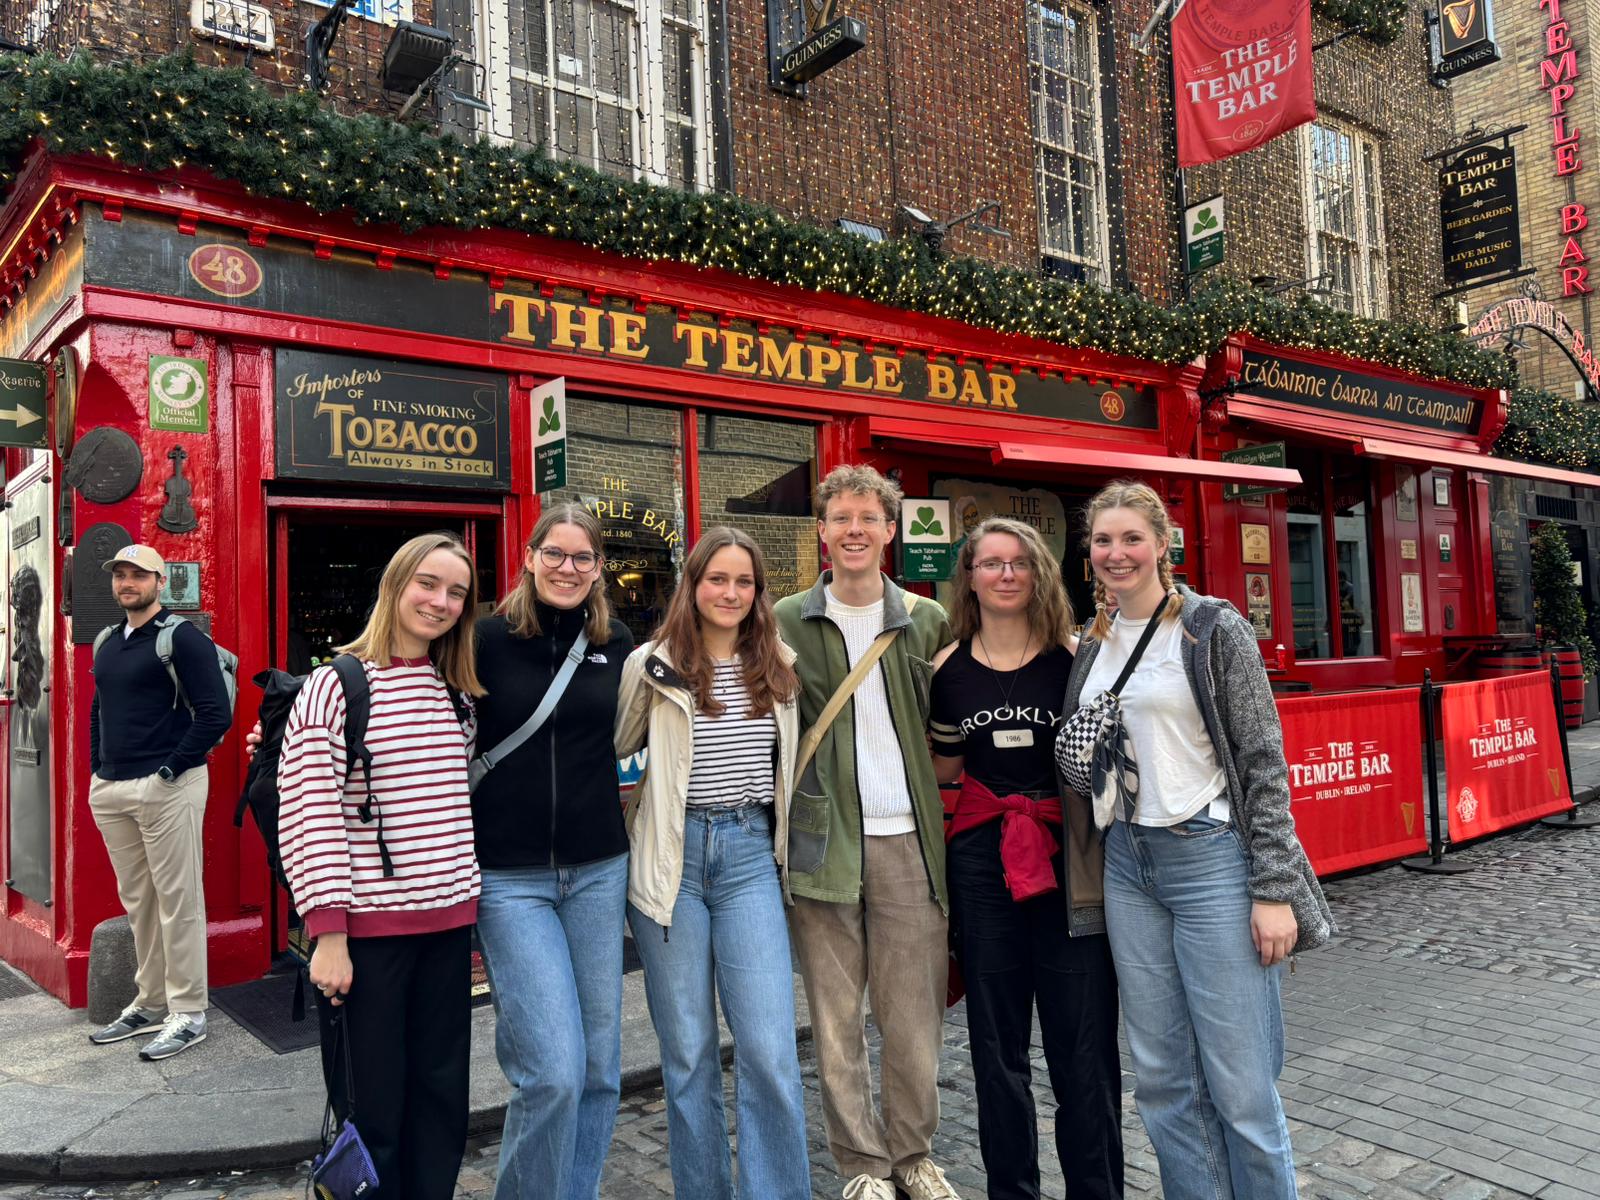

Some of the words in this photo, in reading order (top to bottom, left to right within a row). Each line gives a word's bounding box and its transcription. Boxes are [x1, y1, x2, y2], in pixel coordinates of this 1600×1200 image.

[785, 24, 842, 72] GUINNESS
[1221, 38, 1271, 69] THE
[1186, 39, 1297, 104] TEMPLE
[1440, 46, 1494, 74] GUINNESS
[1539, 0, 1583, 176] TEMPLE
[1218, 81, 1278, 120] BAR
[1465, 151, 1488, 165] THE
[1442, 156, 1513, 186] TEMPLE
[1460, 177, 1497, 197] BAR
[1446, 217, 1471, 230] BEER
[1472, 205, 1513, 222] GARDEN
[1450, 249, 1475, 263] LIVE
[1477, 240, 1512, 256] MUSIC
[1465, 254, 1498, 269] DAILY
[1559, 204, 1594, 297] BAR
[202, 253, 247, 285] 48
[493, 292, 650, 359] THE
[674, 321, 904, 395] TEMPLE
[927, 363, 1019, 410] BAR
[286, 368, 382, 401] Importers
[347, 388, 364, 400] OF
[163, 406, 195, 417] Official
[373, 399, 407, 415] FINE
[410, 402, 476, 421] SMOKING
[1103, 395, 1119, 415] 48
[160, 414, 198, 425] Member
[314, 401, 478, 459] TOBACCO
[350, 450, 412, 469] Always
[422, 458, 437, 470] in
[444, 457, 490, 474] Stock
[602, 477, 630, 491] THE
[1009, 495, 1041, 515] THE
[615, 530, 633, 538] 1840
[642, 508, 681, 549] BAR
[1494, 718, 1512, 733] THE
[1006, 735, 1021, 743] 1986
[1328, 741, 1354, 759] THE
[1469, 733, 1513, 758] TEMPLE
[1515, 727, 1537, 749] BAR
[1289, 760, 1356, 788] TEMPLE
[1361, 753, 1393, 778] BAR
[1487, 757, 1505, 768] DUBLIN
[1507, 753, 1526, 764] IRELAND
[1315, 788, 1340, 800] DUBLIN
[1344, 783, 1371, 796] IRELAND
